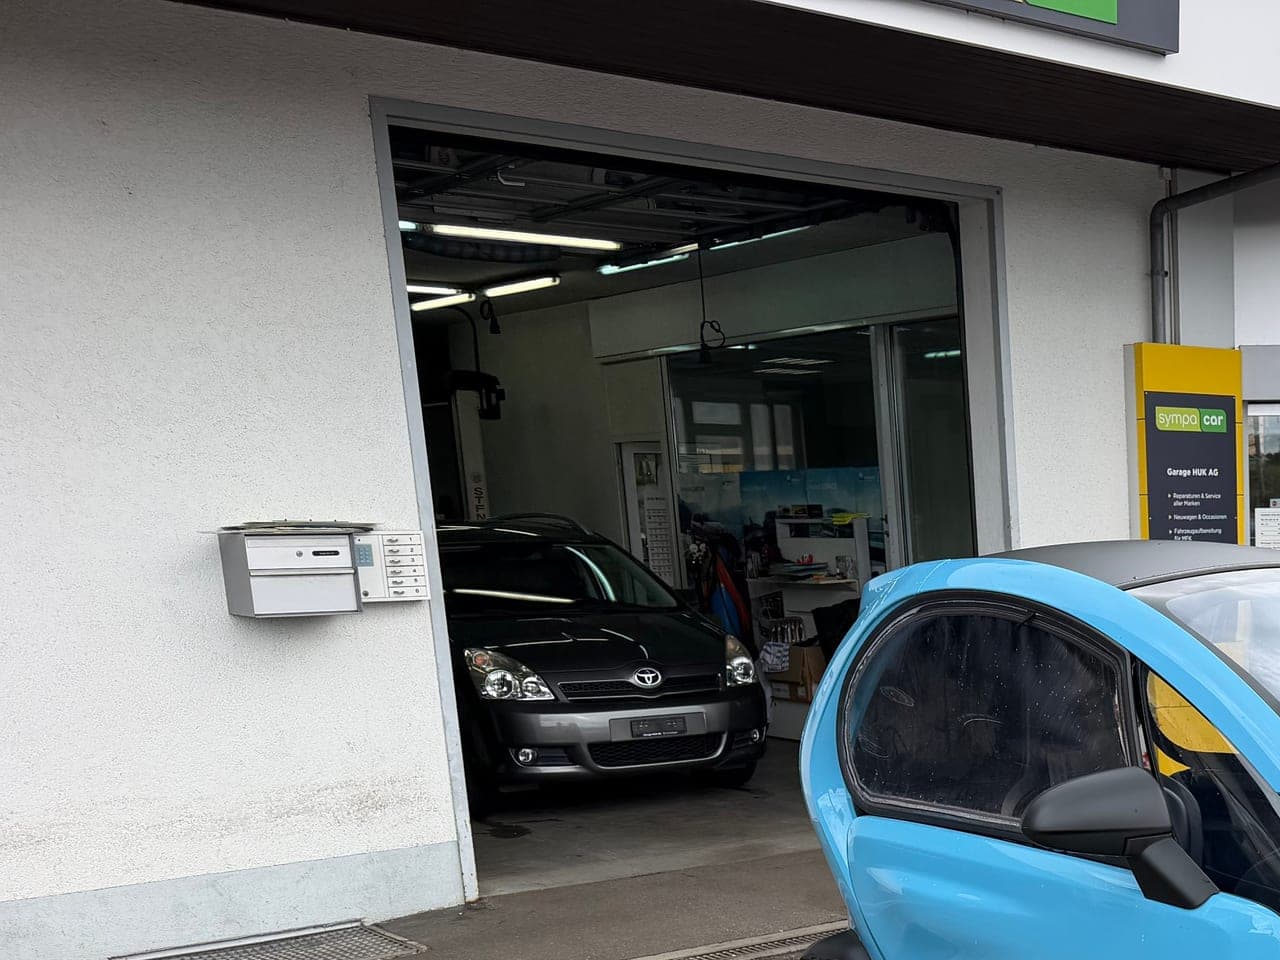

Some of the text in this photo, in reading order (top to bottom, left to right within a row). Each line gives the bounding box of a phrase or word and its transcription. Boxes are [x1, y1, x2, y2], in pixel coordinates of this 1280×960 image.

[1158, 413, 1223, 428] sympa car
[1166, 467, 1219, 477] Garage HUK AG
